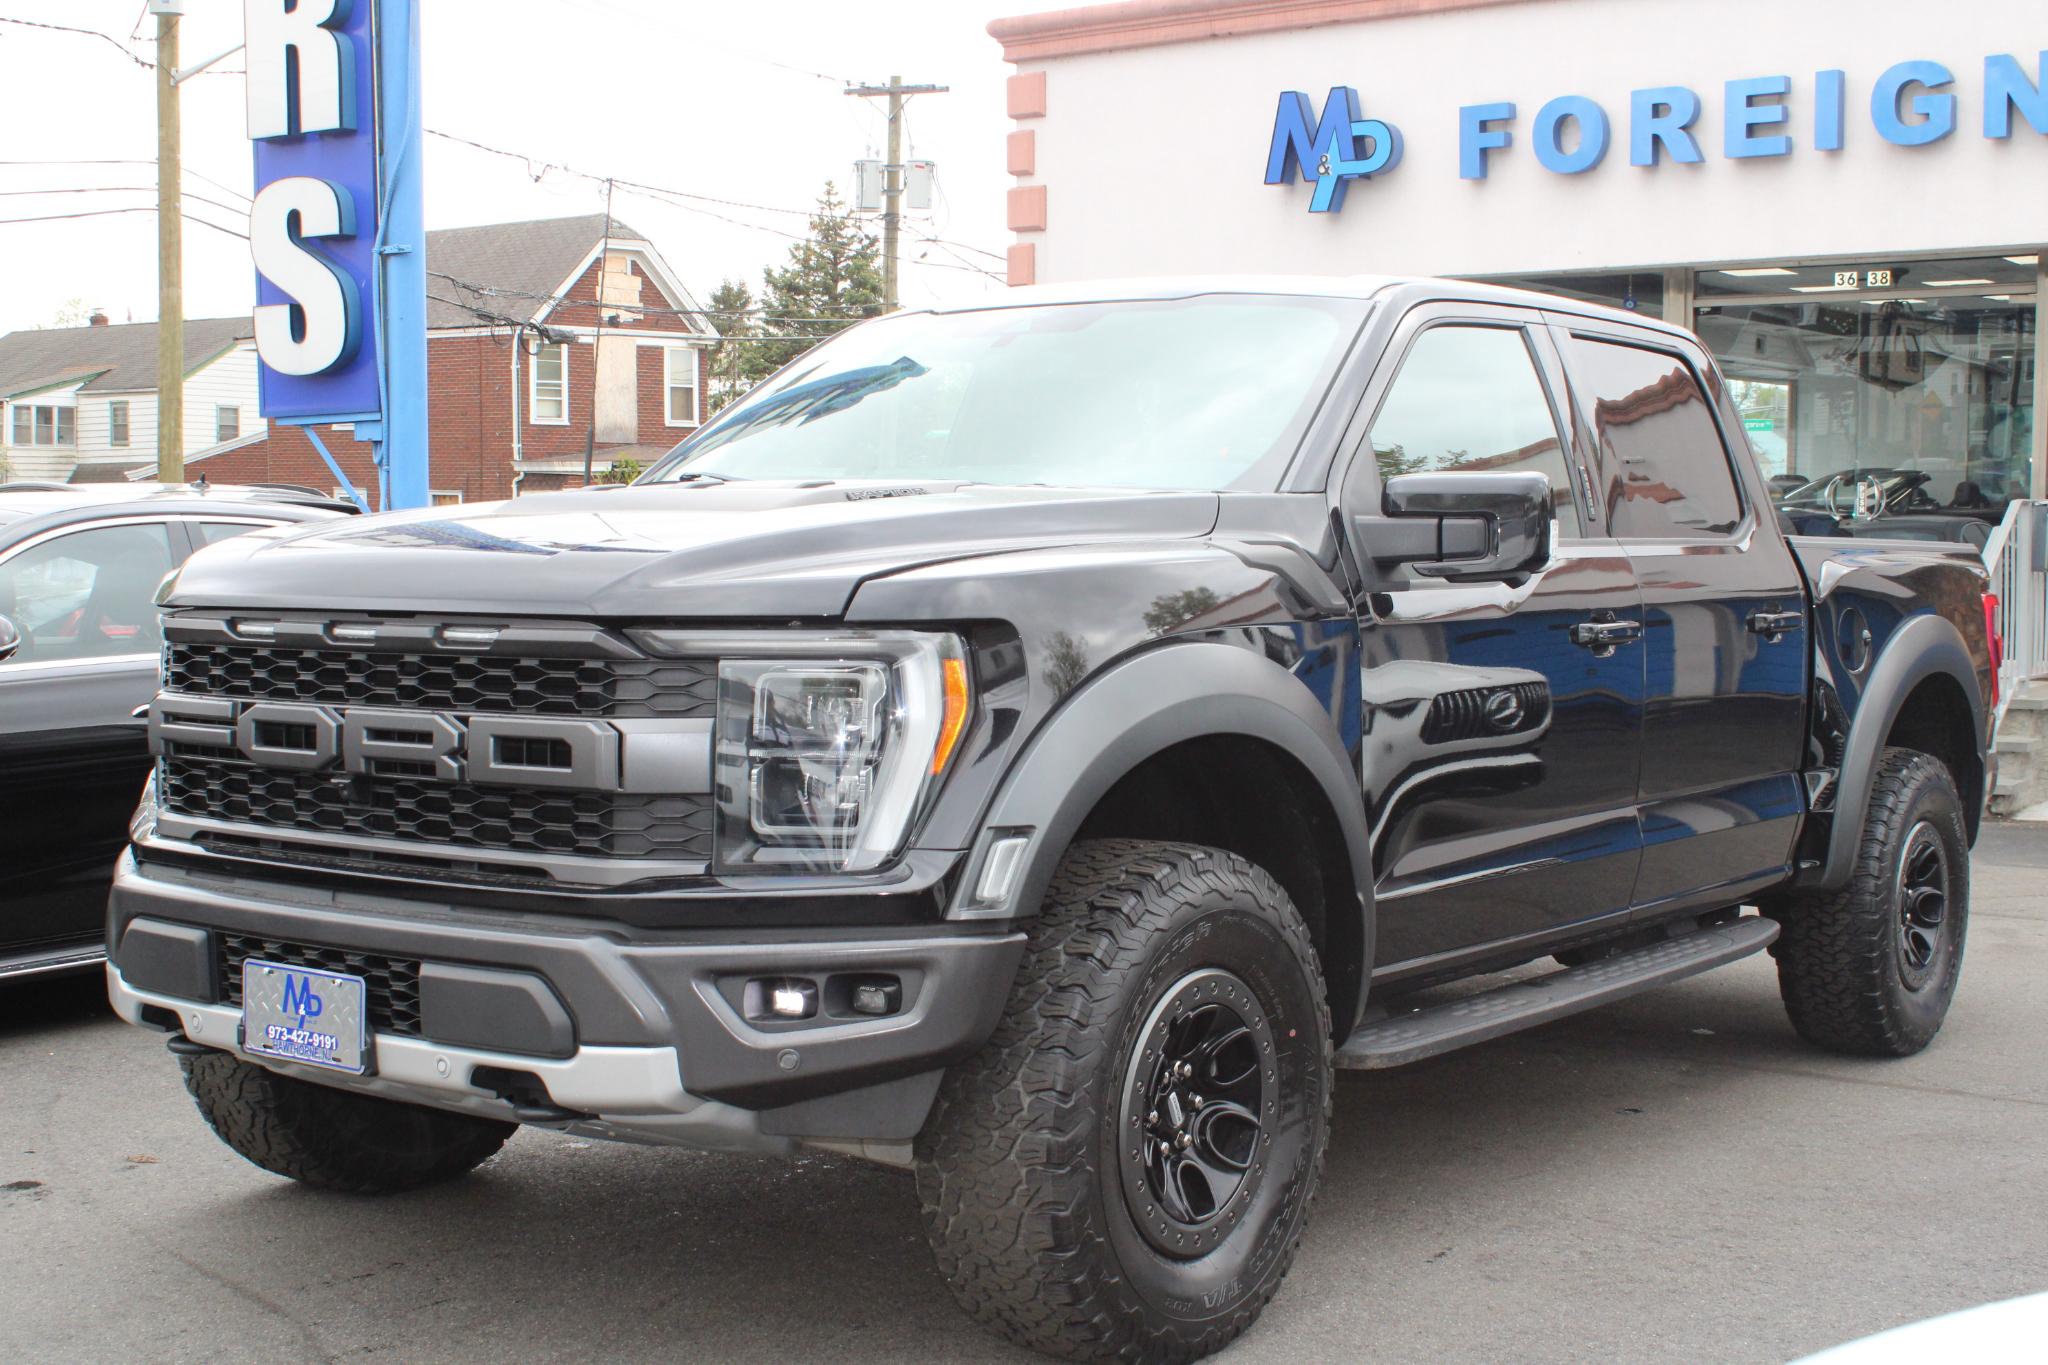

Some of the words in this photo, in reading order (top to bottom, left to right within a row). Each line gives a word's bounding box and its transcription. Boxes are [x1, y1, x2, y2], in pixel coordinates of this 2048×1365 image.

[1458, 53, 2048, 180] FOREIGN
[1836, 273, 1856, 286] 36
[1869, 271, 1889, 285] 38
[148, 697, 621, 791] FORD
[267, 1025, 337, 1050] 973-427-9191
